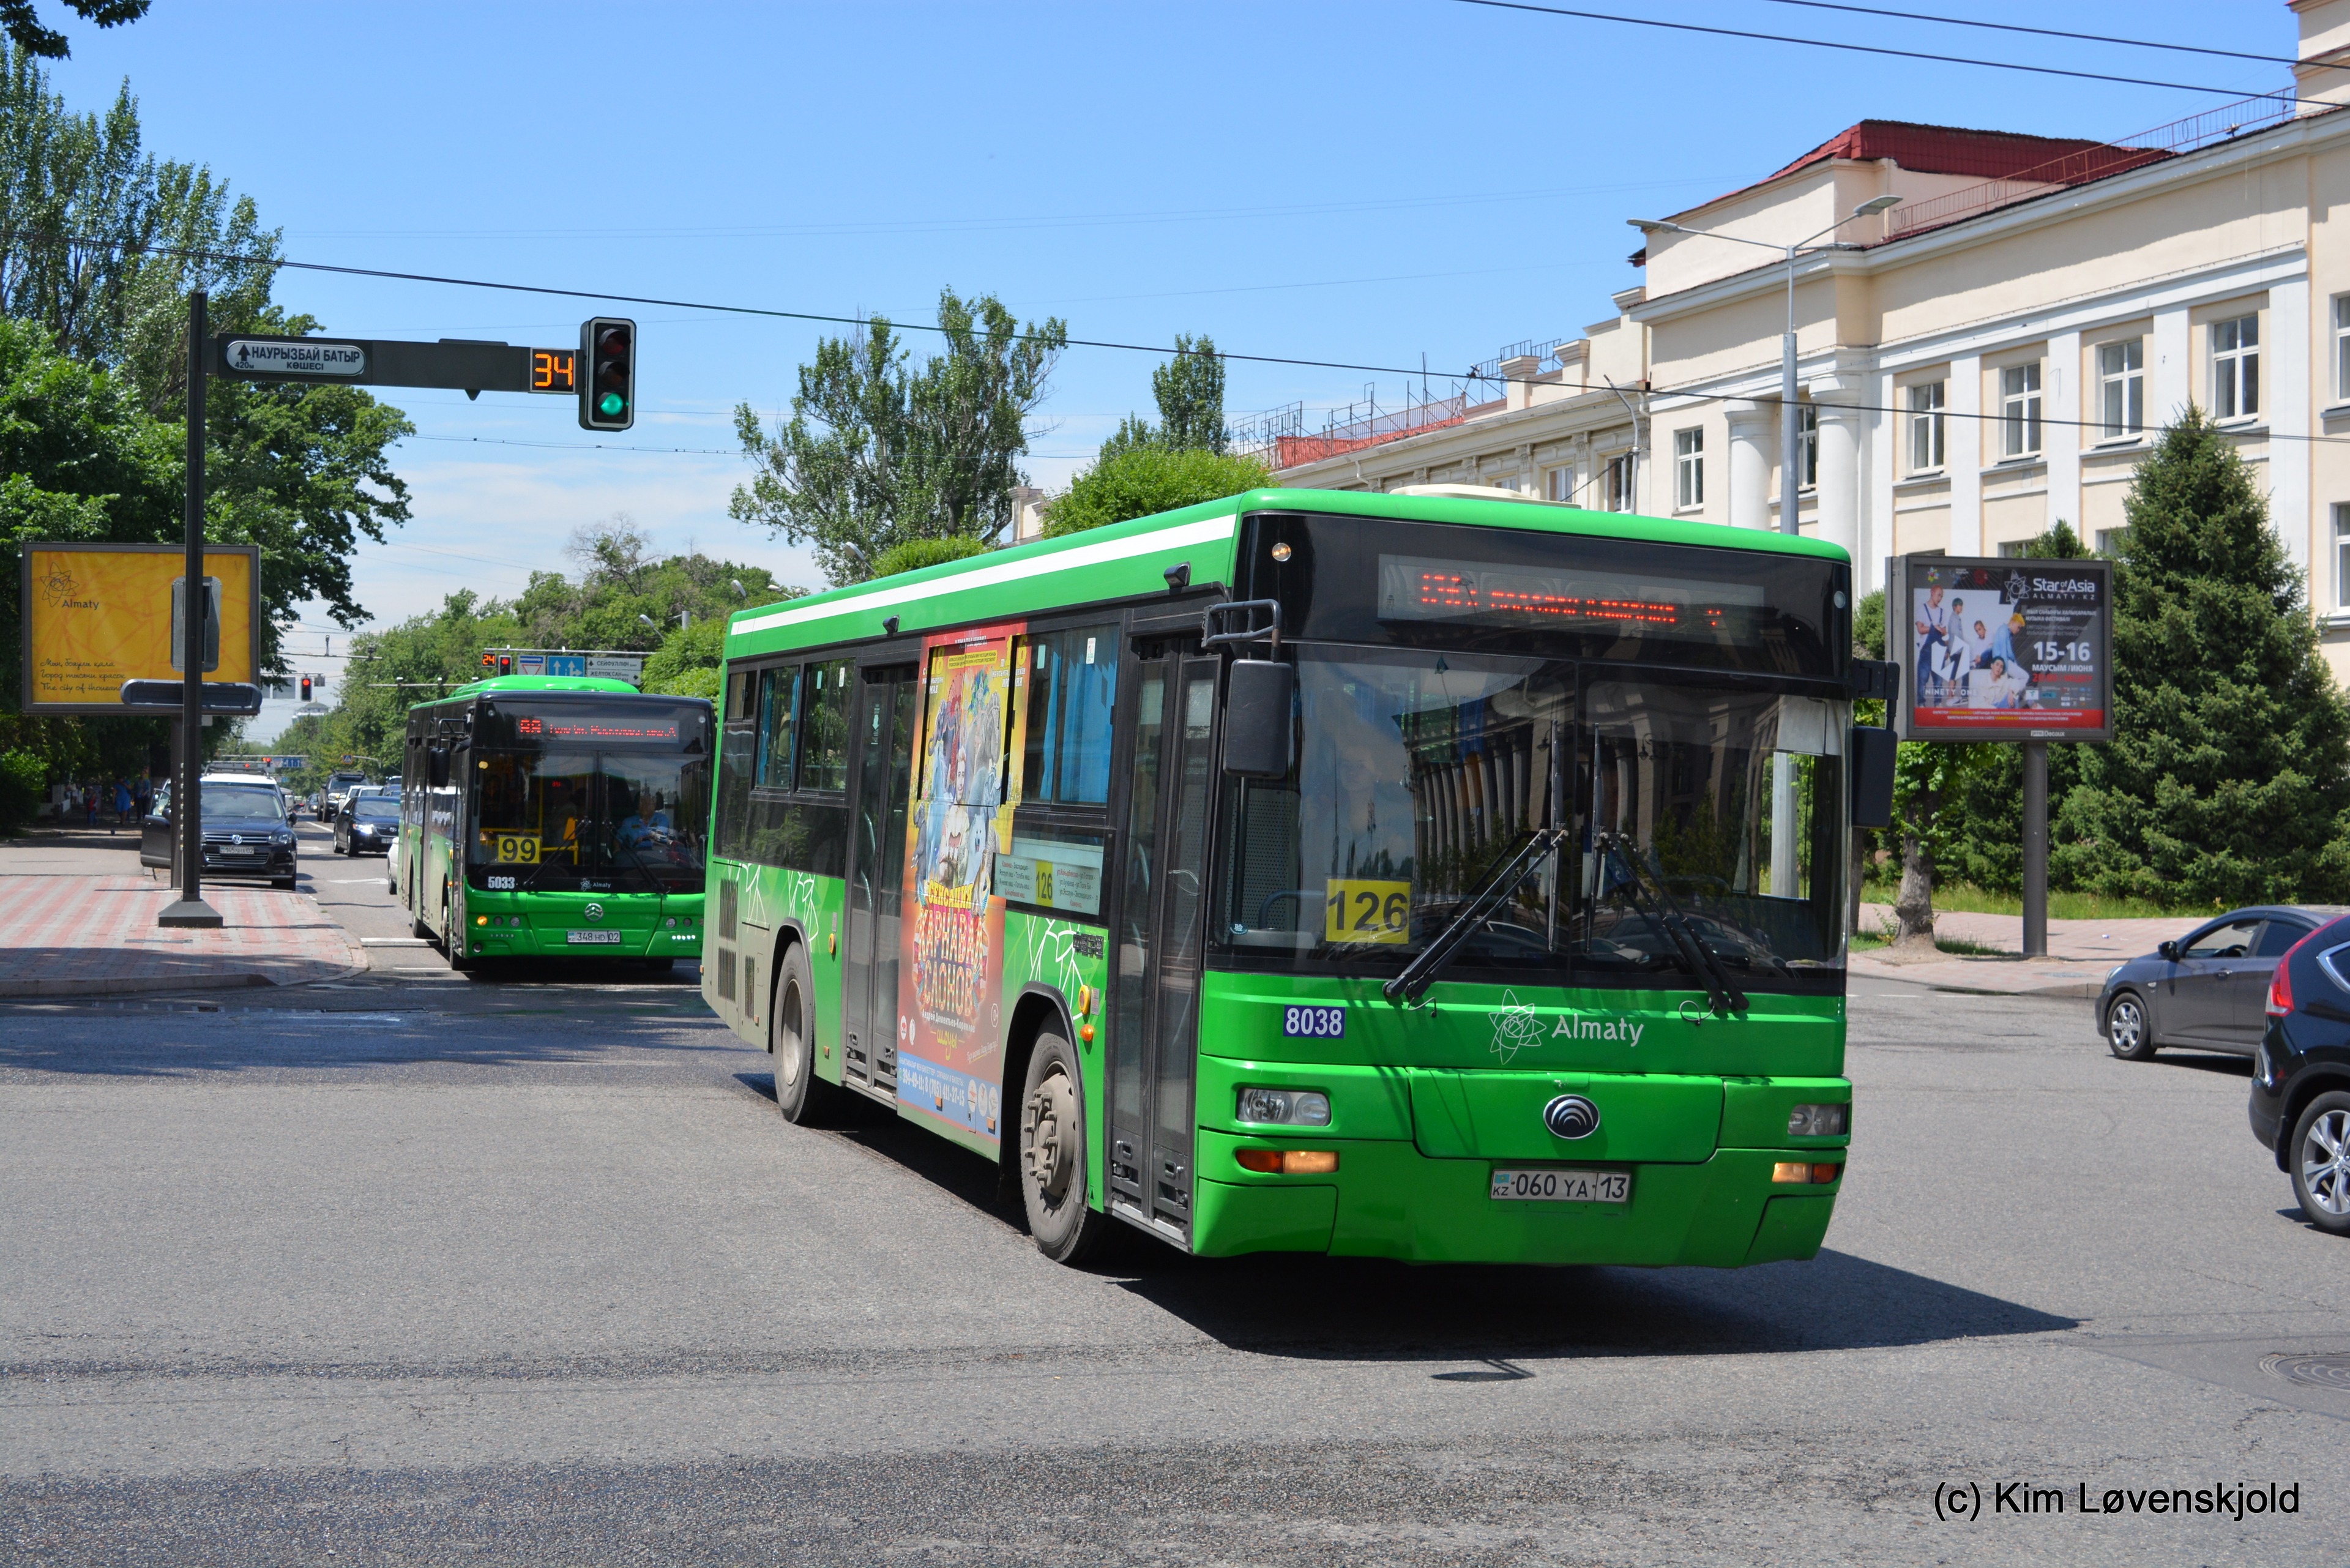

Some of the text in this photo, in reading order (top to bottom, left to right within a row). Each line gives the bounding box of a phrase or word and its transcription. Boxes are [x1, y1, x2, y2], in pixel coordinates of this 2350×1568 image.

[252, 346, 360, 363] НАУРЫЗБАЙ БАТЫР
[286, 362, 324, 370] КӨШЕСІ
[534, 353, 573, 386] 34
[2033, 578, 2059, 592] Star
[2067, 579, 2095, 592] Asia
[62, 600, 99, 610] Almaty
[482, 655, 495, 665] 24
[2034, 641, 2091, 661] 15-16
[40, 670, 63, 681] Город
[60, 684, 73, 693] city
[76, 683, 86, 693] of
[502, 838, 536, 862] 99
[488, 876, 515, 889] 5033
[1036, 872, 1053, 900] 126
[928, 879, 974, 912] СЕНСАЦИЯ
[1327, 890, 1409, 932] 126
[577, 932, 593, 941] 348
[608, 932, 619, 941] 02
[918, 908, 983, 976] КАРНАВАЛ
[924, 959, 974, 1016] СЛОНОВ
[1286, 1007, 1343, 1036] 8038
[1551, 1012, 1644, 1047] Almaty
[925, 1076, 928, 1092] 8
[942, 1083, 964, 1107] 411-27-15
[1493, 1174, 1627, 1198] KZ 060 YA 13
